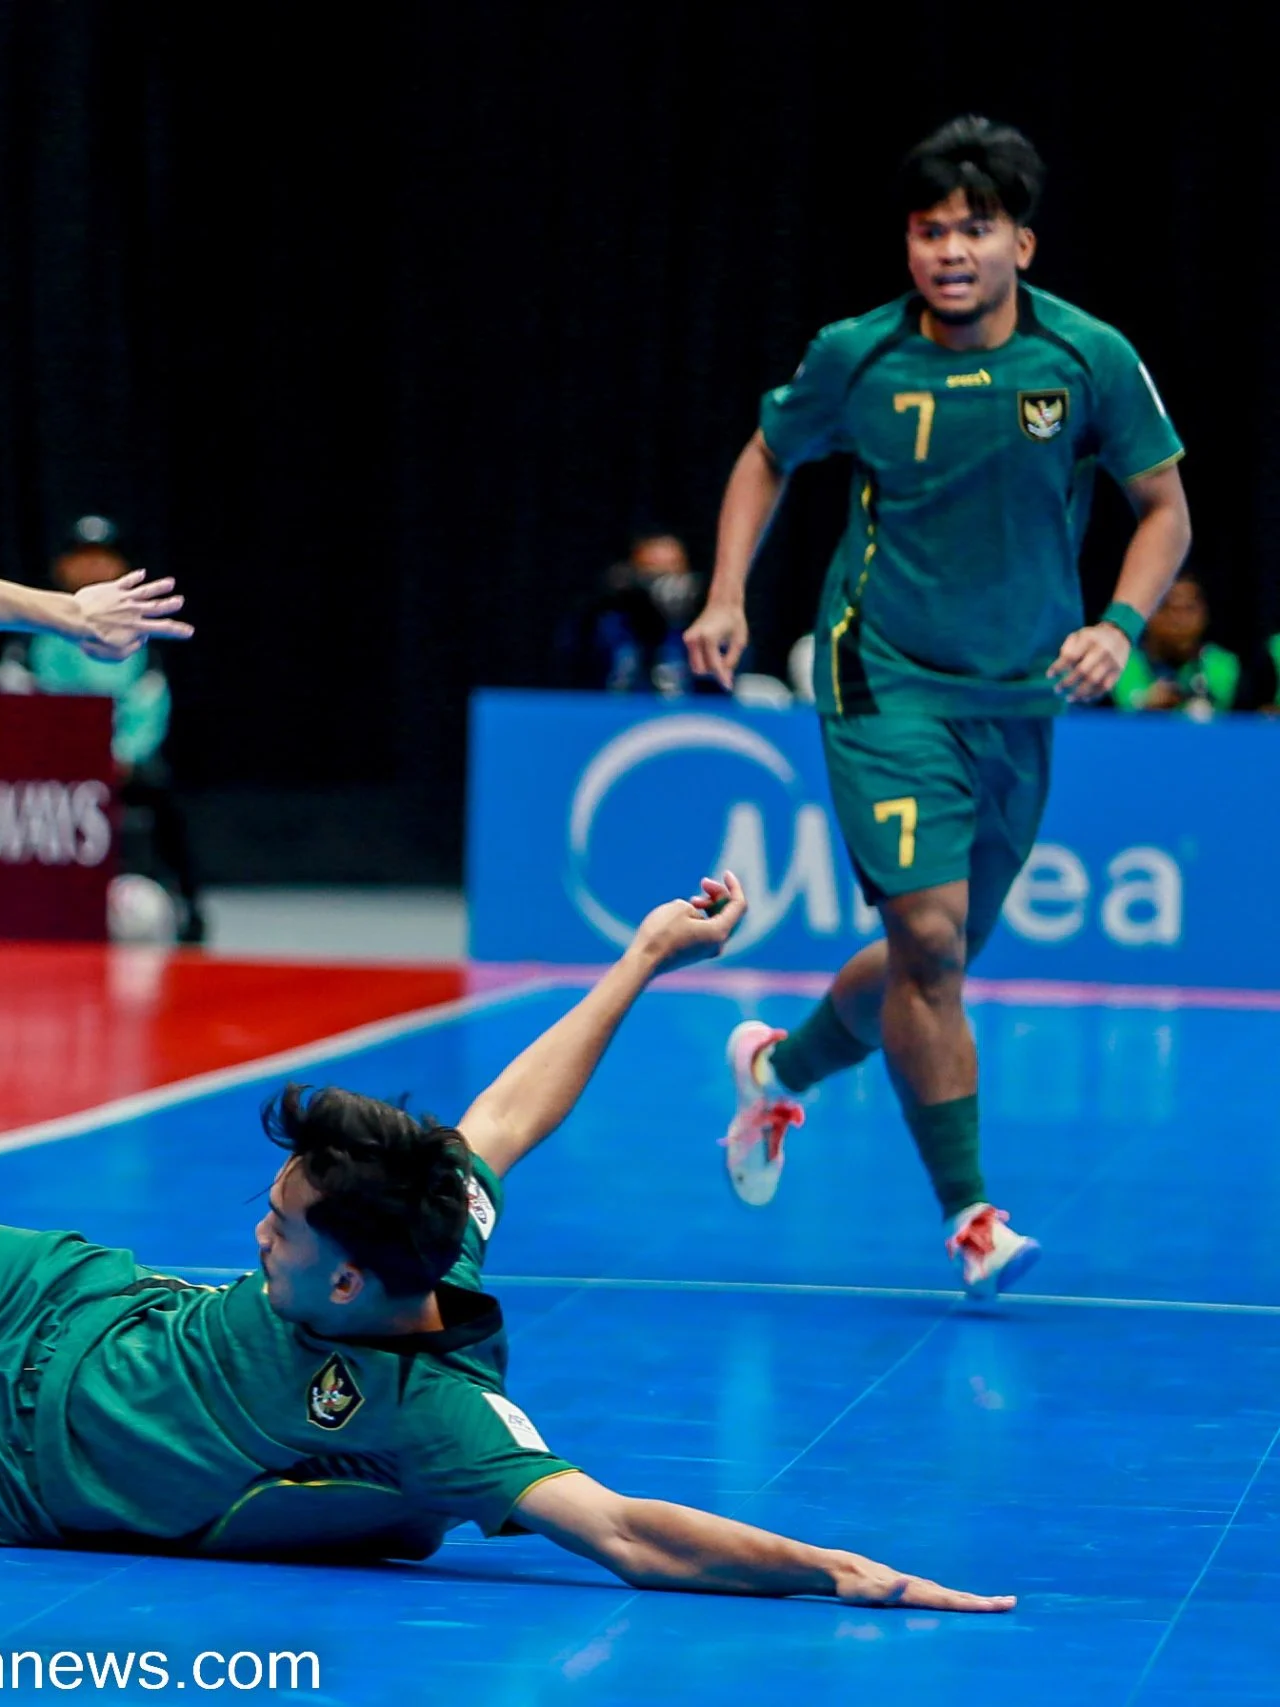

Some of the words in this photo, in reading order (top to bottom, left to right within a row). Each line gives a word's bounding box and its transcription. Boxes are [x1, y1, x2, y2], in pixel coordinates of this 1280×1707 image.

[893, 391, 935, 461] 7
[874, 797, 917, 867] 7
[712, 802, 1183, 945] Mea
